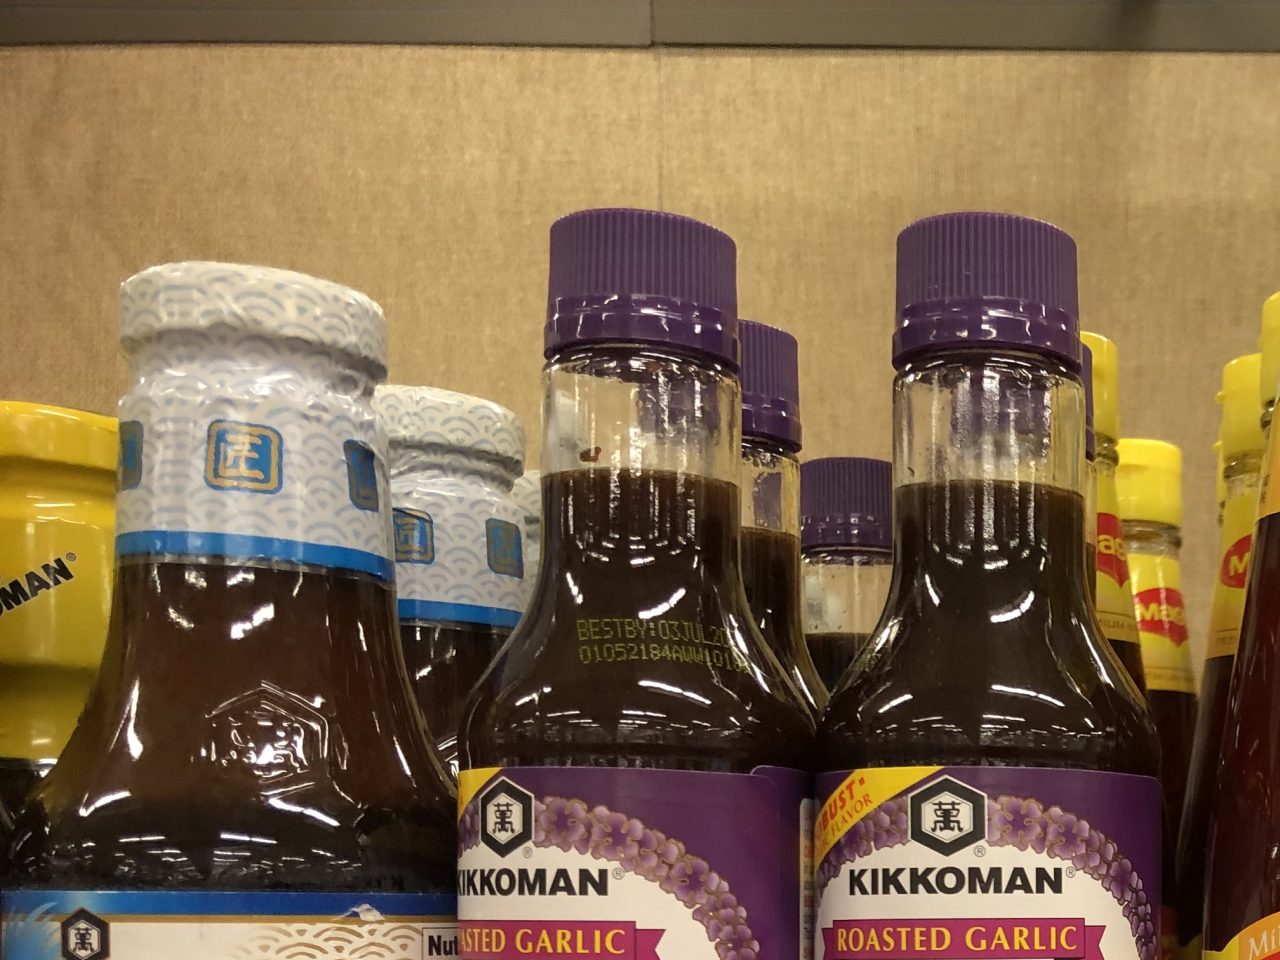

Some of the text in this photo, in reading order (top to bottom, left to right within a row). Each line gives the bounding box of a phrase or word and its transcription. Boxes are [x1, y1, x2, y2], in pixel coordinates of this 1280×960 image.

[849, 866, 1063, 896] KIKKOMAN
[516, 928, 626, 955] GARLIC
[837, 925, 1077, 952] ROASTED GARLIC
